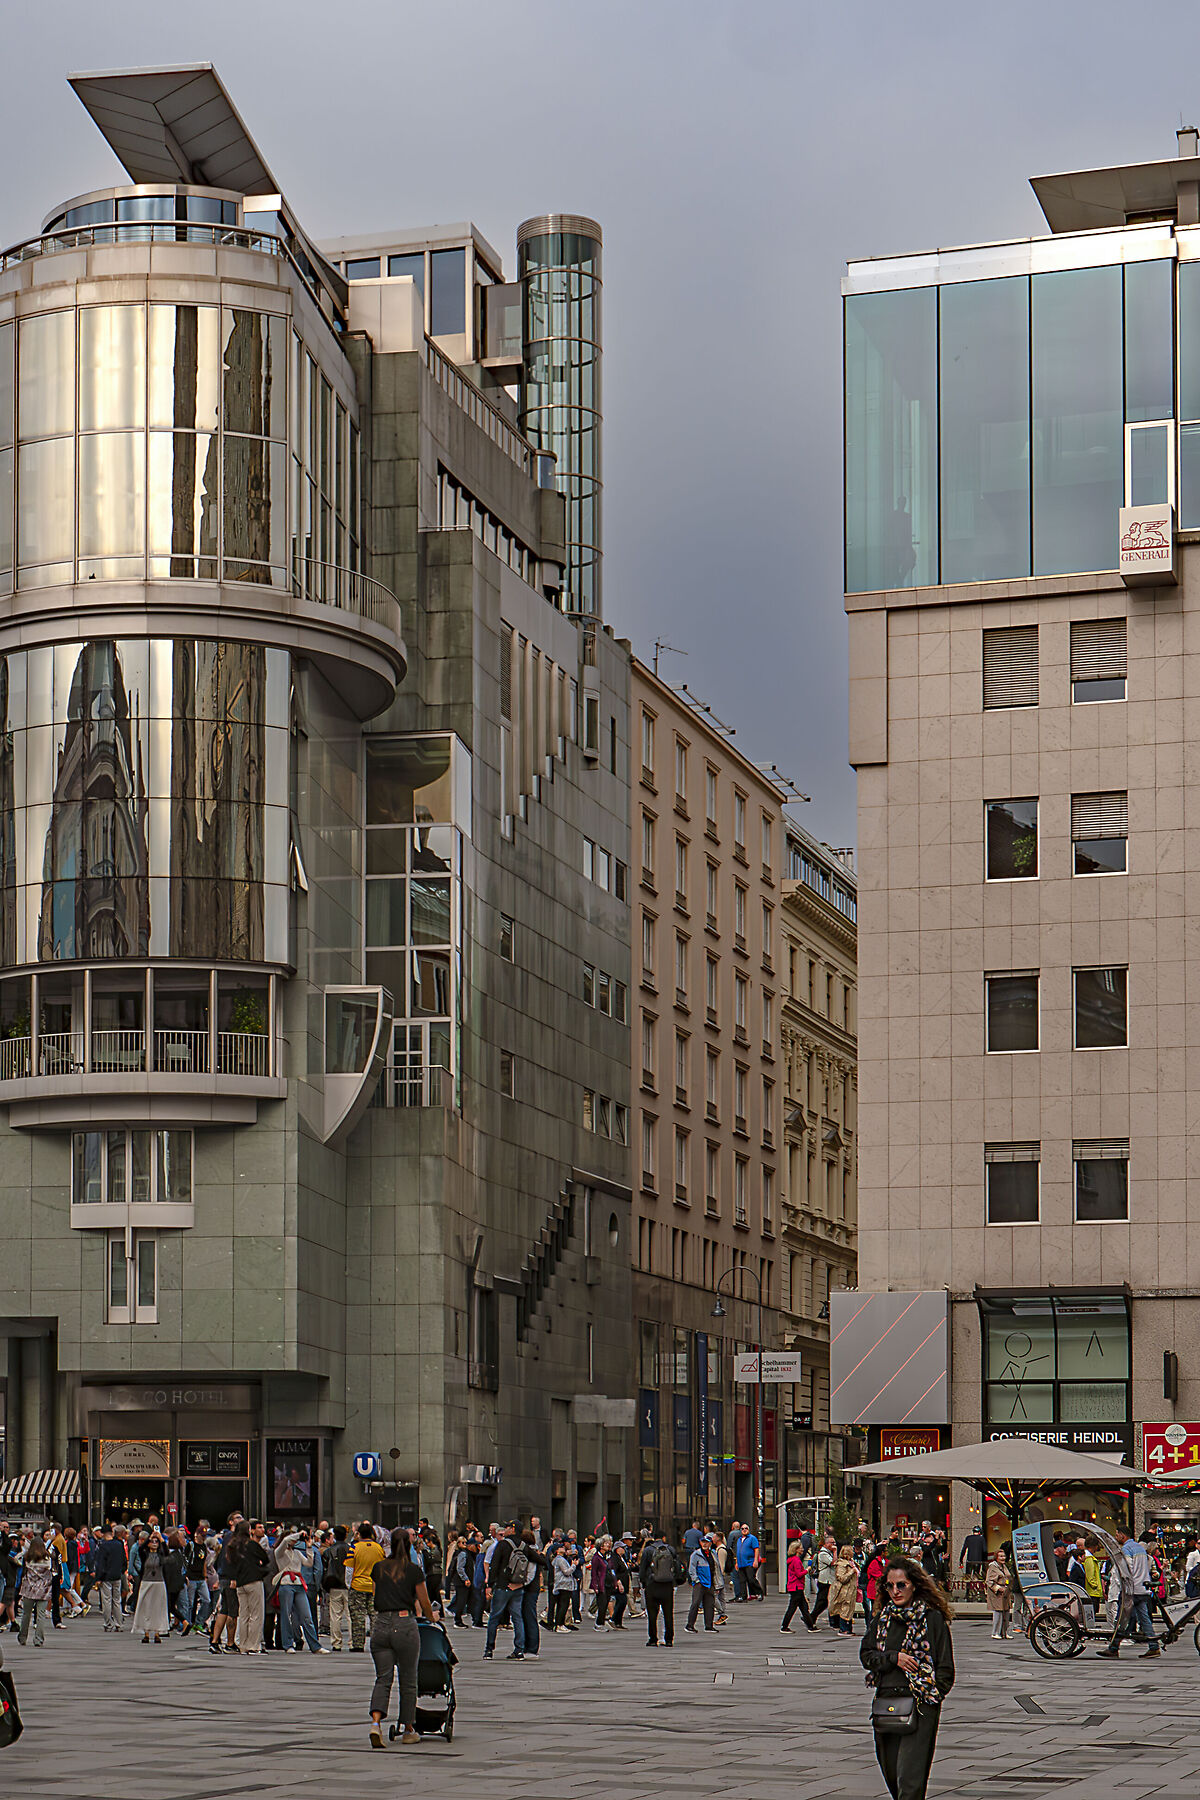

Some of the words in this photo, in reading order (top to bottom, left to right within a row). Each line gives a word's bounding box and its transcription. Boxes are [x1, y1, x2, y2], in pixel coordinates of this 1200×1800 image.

[1121, 549, 1170, 562] GENERALI
[1073, 1432, 1124, 1444] HEINDL
[356, 1457, 374, 1476] U
